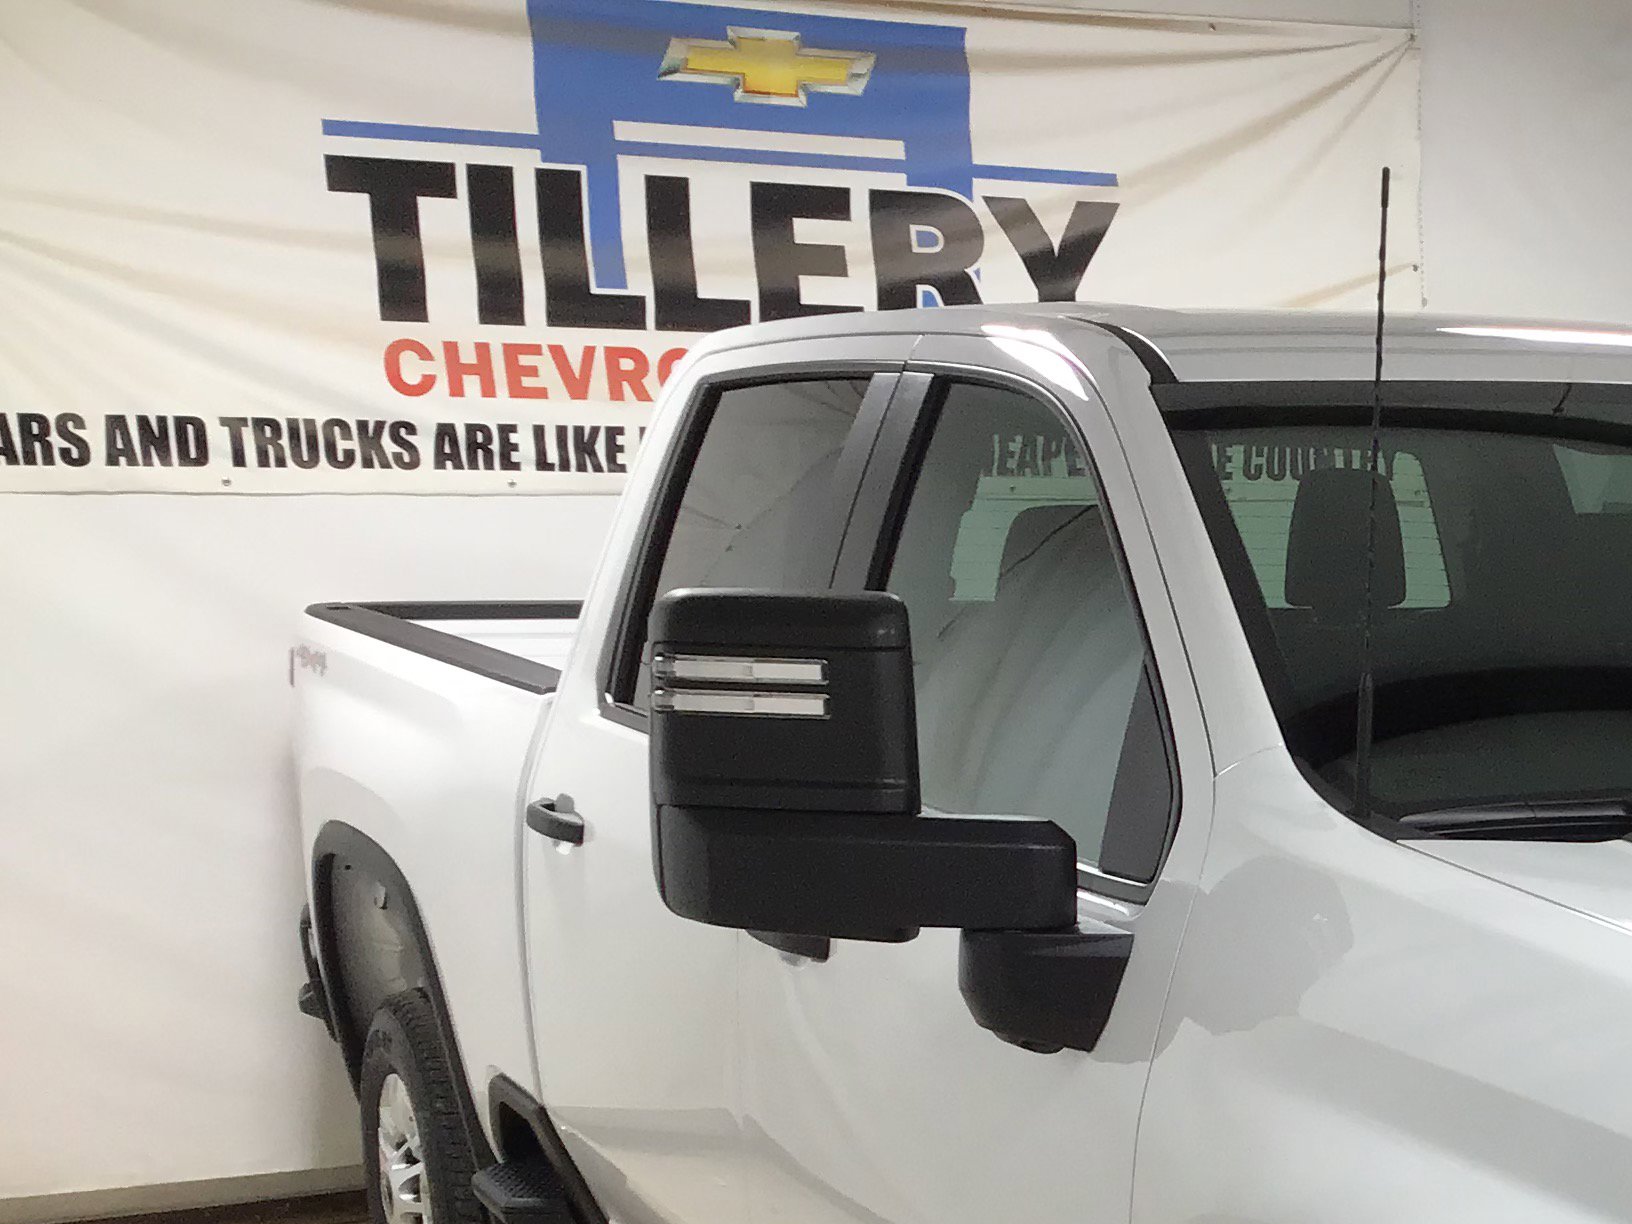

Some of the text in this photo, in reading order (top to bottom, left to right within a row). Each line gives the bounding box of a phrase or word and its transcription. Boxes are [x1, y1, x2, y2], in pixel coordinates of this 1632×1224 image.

[323, 153, 1121, 333] TILLERY
[104, 413, 210, 468] AND
[218, 415, 422, 471] TRUCKS
[432, 422, 522, 471] ARE
[531, 423, 628, 473] LIKE
